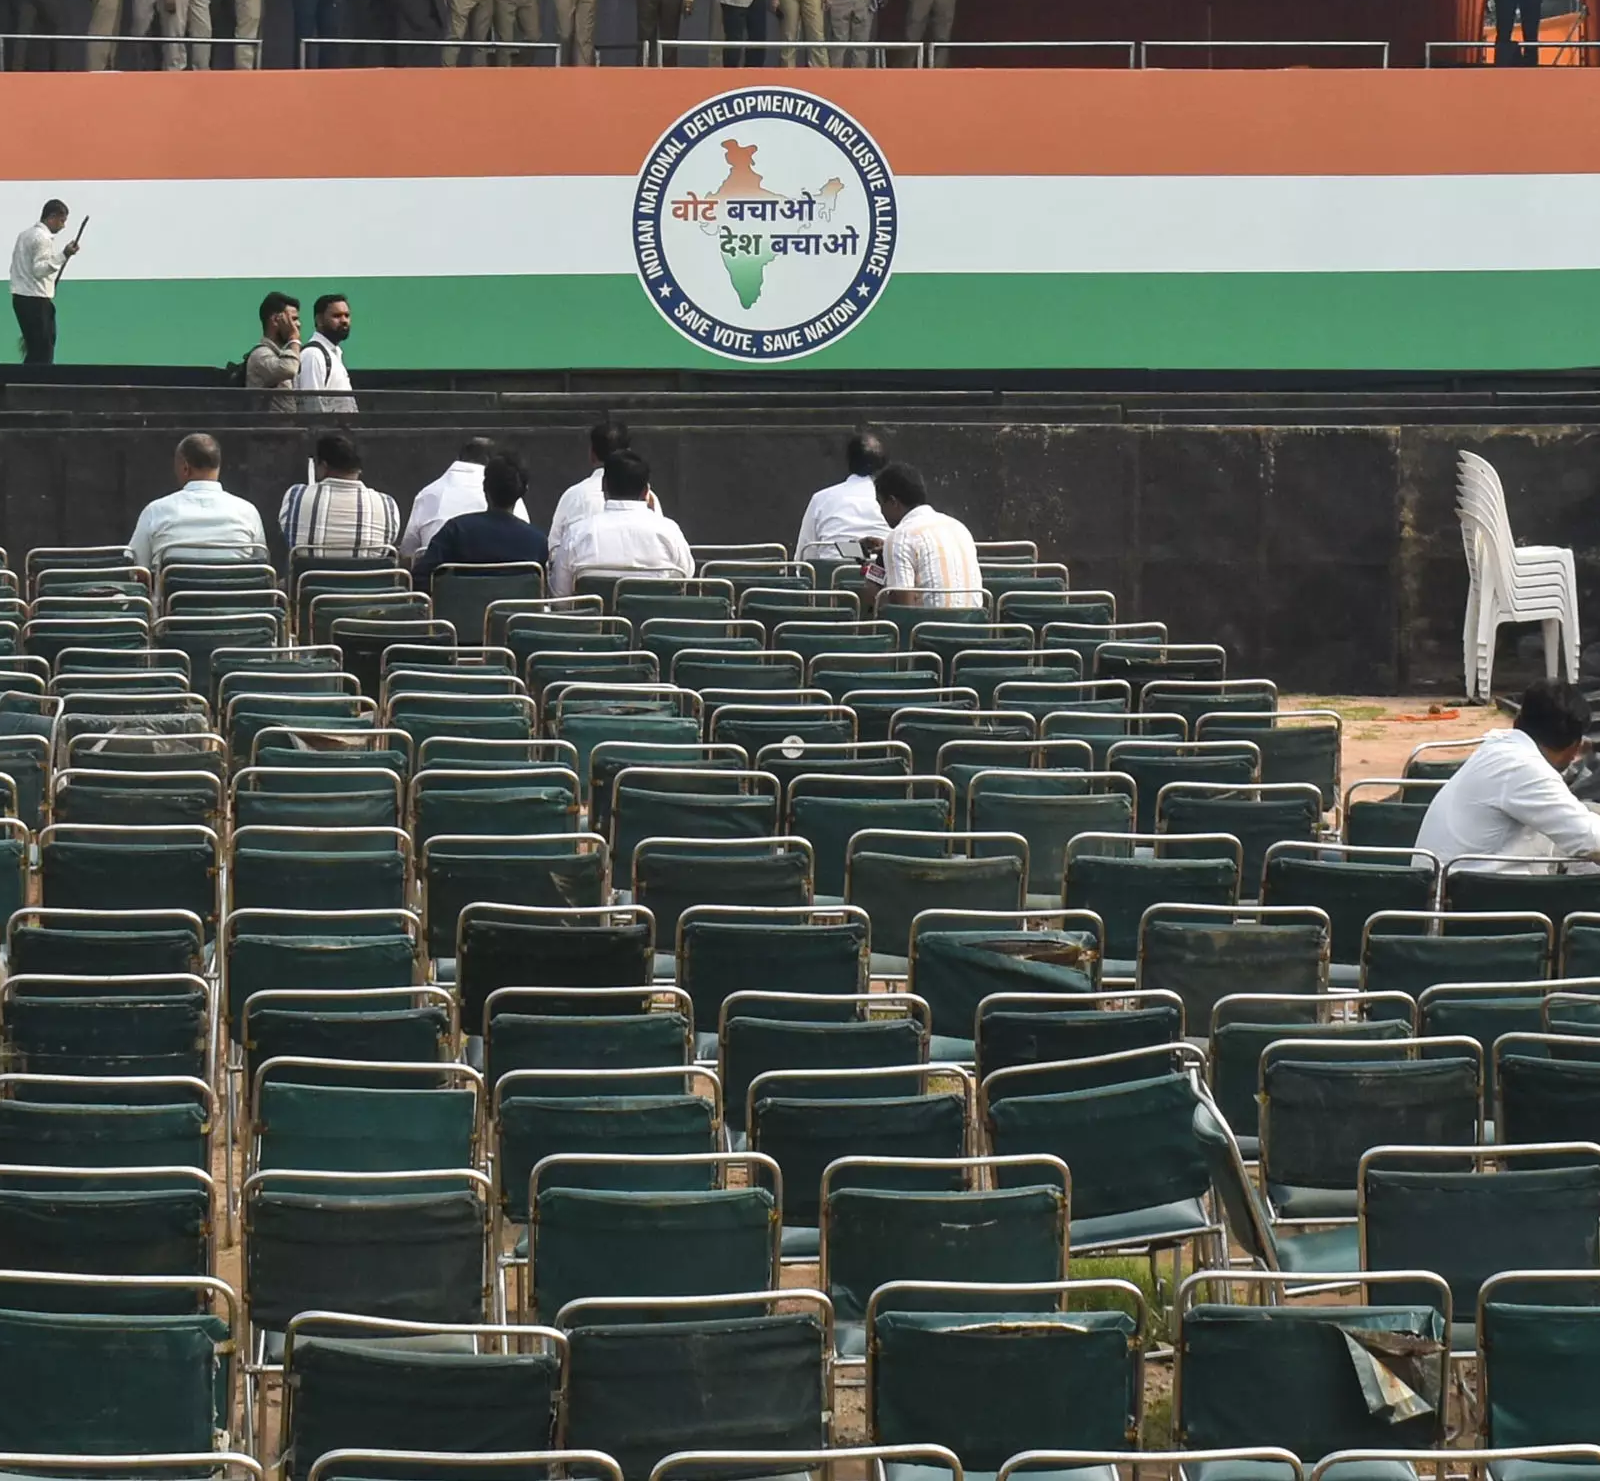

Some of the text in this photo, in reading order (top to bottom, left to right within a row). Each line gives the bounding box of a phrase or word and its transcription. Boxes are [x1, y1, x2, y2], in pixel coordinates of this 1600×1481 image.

[638, 95, 891, 280] INDIAN NATIONAL DEVELOPMENTAL INCLUSIVE ALLIANCE
[671, 191, 815, 221] वोट बचाओ
[720, 226, 859, 256] देश बचाओ
[674, 298, 858, 353] SAVE VOTE, SAVE NATION
